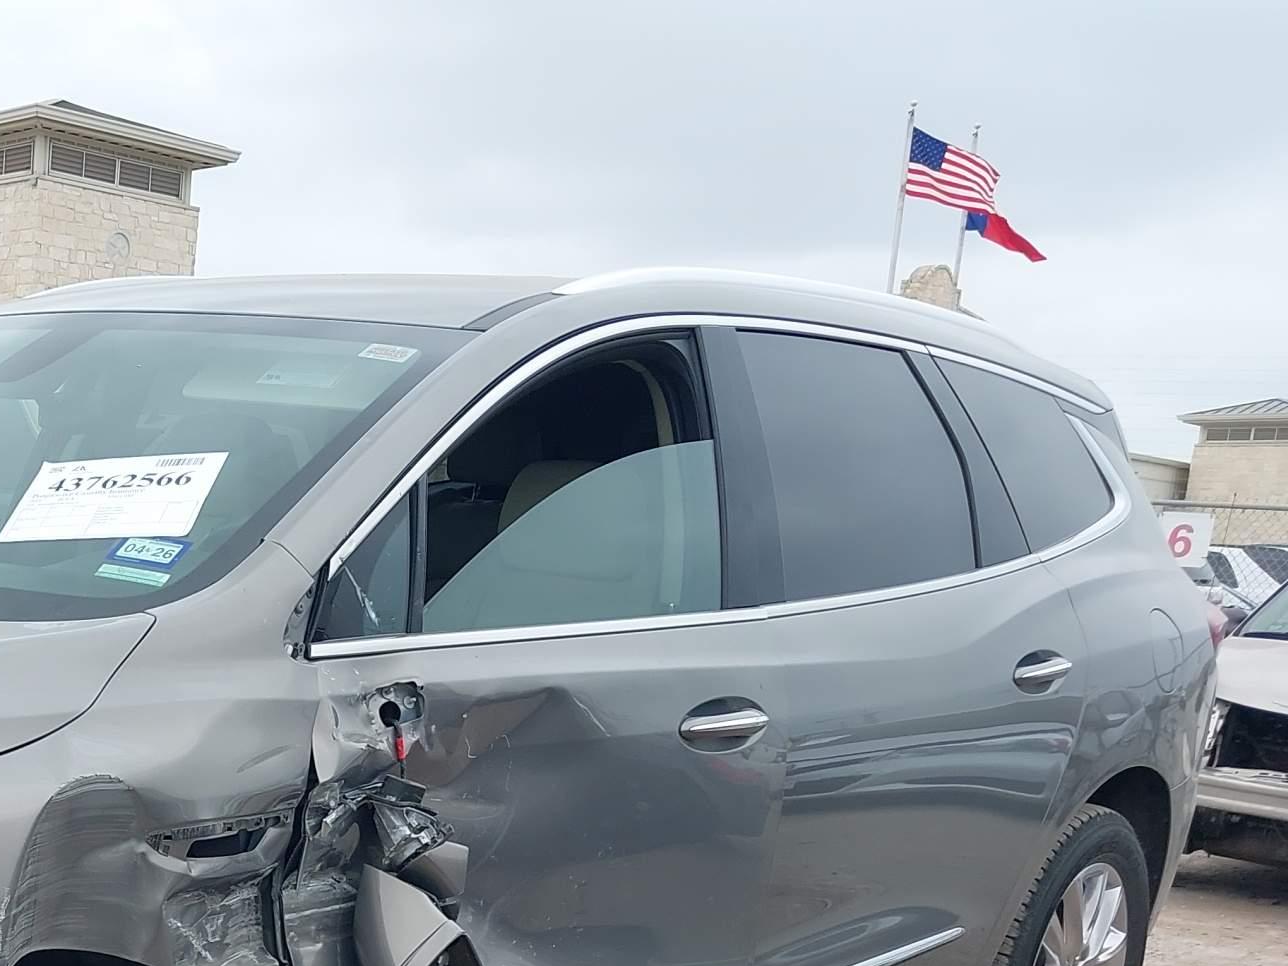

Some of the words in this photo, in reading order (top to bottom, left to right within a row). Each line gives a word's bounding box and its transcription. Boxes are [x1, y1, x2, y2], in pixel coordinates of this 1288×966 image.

[49, 471, 194, 492] 43762566
[123, 543, 147, 554] 04
[151, 547, 176, 559] 26
[1168, 523, 1194, 558] 6
